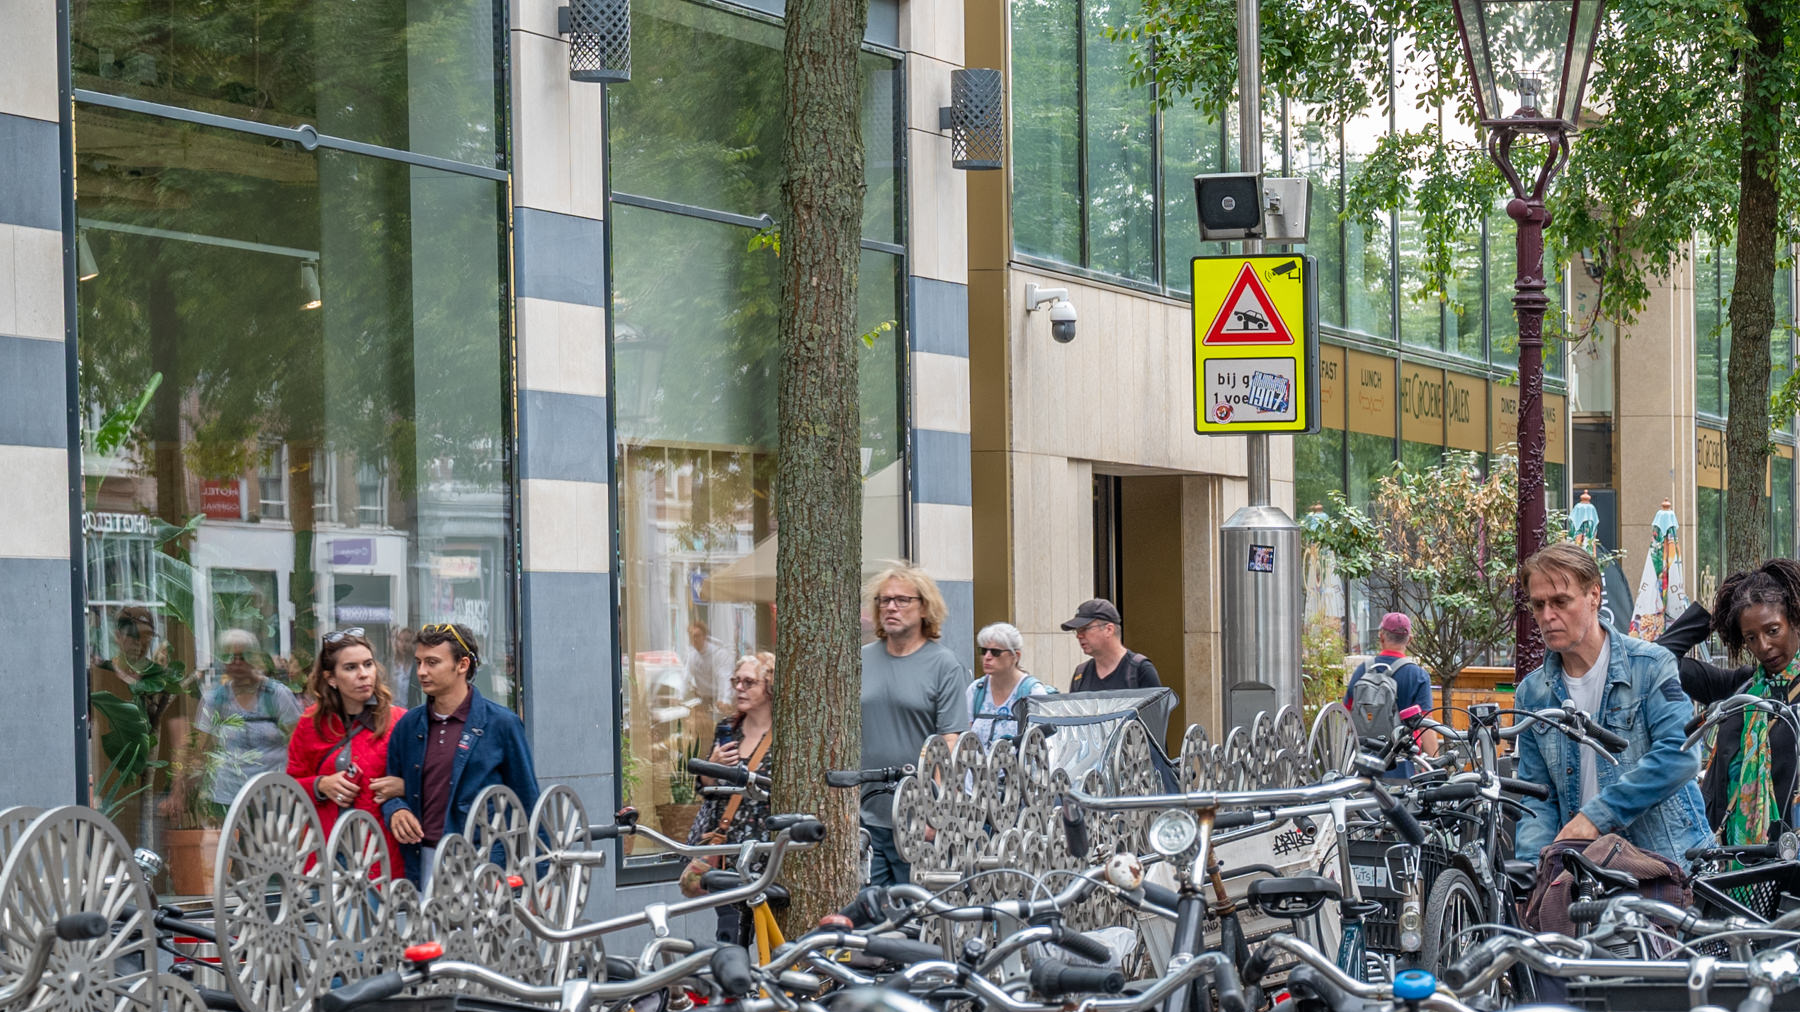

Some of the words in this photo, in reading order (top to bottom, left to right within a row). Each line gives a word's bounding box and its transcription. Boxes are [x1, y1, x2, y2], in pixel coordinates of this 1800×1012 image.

[1218, 373, 1236, 389] bij
[1361, 369, 1382, 389] LUNCH
[1501, 397, 1517, 413] DINER
